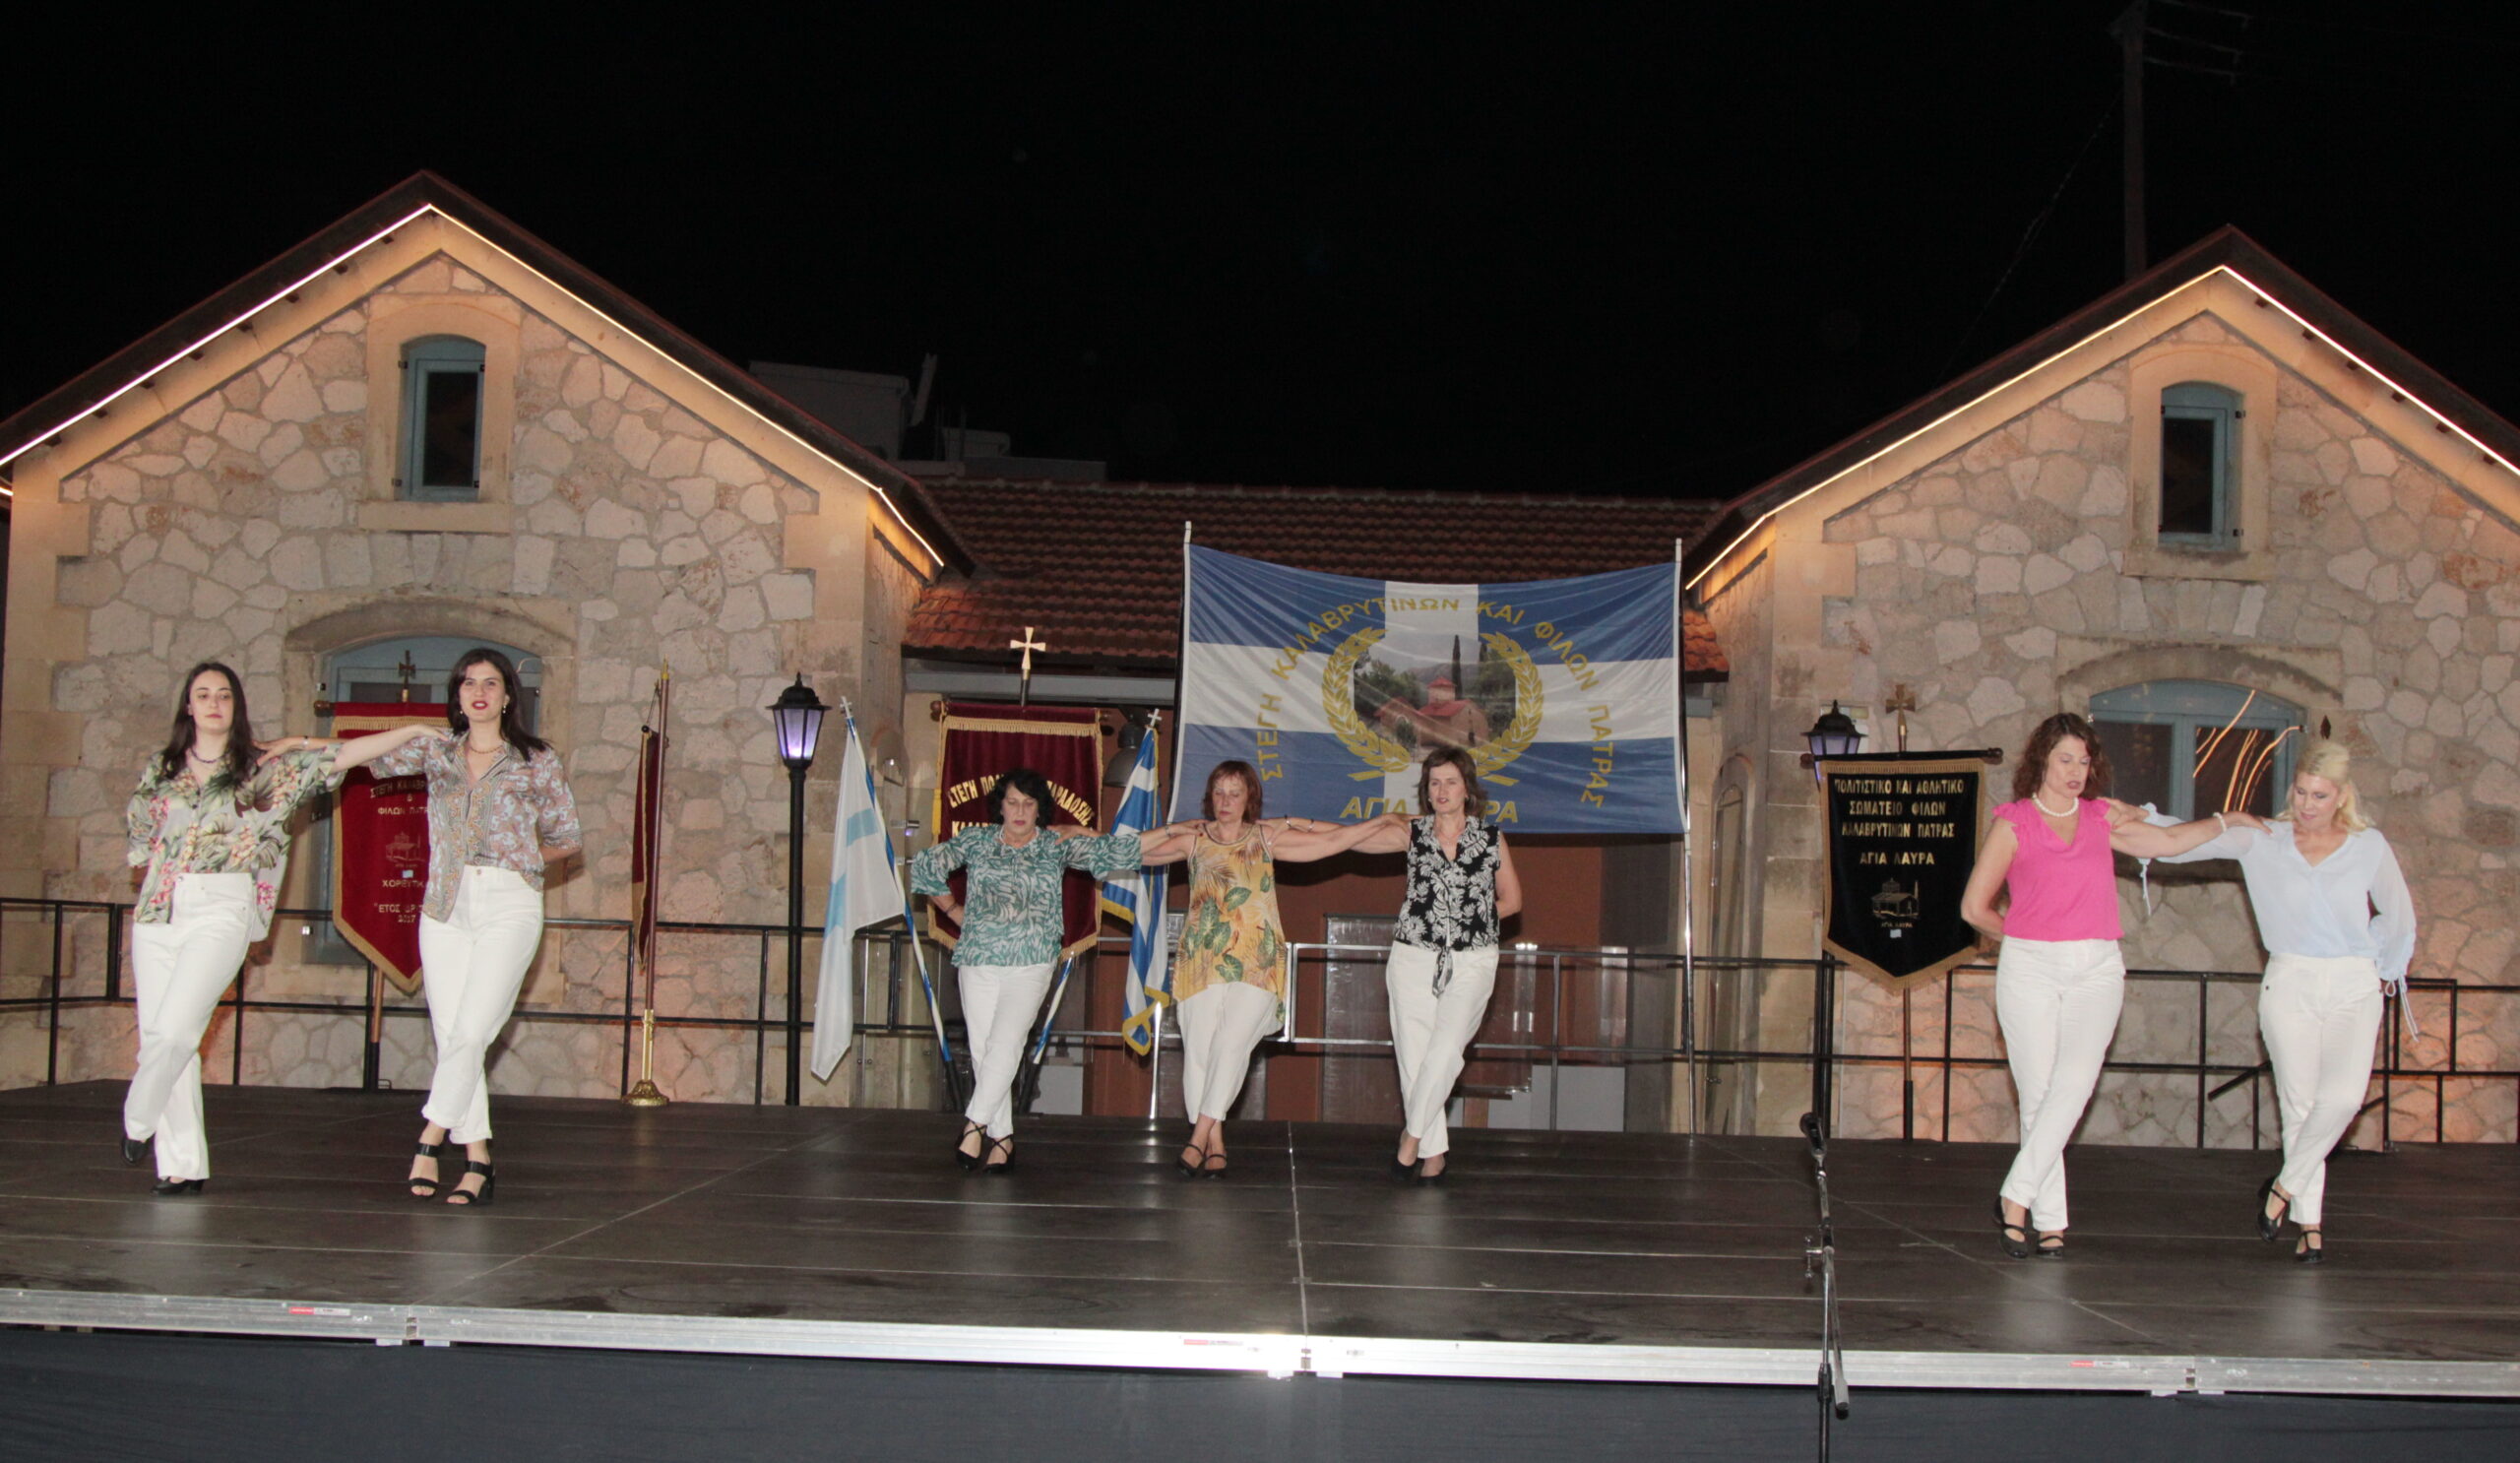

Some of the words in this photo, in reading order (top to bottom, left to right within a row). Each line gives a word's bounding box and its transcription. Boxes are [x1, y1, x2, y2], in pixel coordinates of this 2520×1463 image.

[1256, 692, 1284, 782] ΣΤΕΓΗ
[1270, 597, 1460, 681] ΚΑΛΑΒΡΥΤΙΝΩΝ
[1476, 600, 1526, 626] ΚΑΙ
[1534, 620, 1600, 692] ΦΙΛΩΝ
[1580, 704, 1614, 809] ΠΑΤΡΑΣ
[947, 780, 978, 808] ΣΤΕΓΗ
[1834, 779, 1892, 794] ΠΟΛΙΤΙΣΤΙΚΟ
[1896, 780, 1912, 794] ΚΑΙ
[1917, 779, 1965, 794] ΑΘΛΗΤΙΚΟ
[1850, 800, 1903, 816] ΣΩΜΑΤΕΙΟ
[1911, 801, 1946, 816] ΦΙΛΩΝ
[1842, 822, 1911, 838] ΚΑΛΑΒΡΥΤΙΝΩΝ
[1918, 823, 1955, 838] ΠΑΤΡΑΣ
[1859, 852, 1887, 865] ΑΓΙΑ
[1894, 852, 1935, 865] ΛΑΥΡΑ
